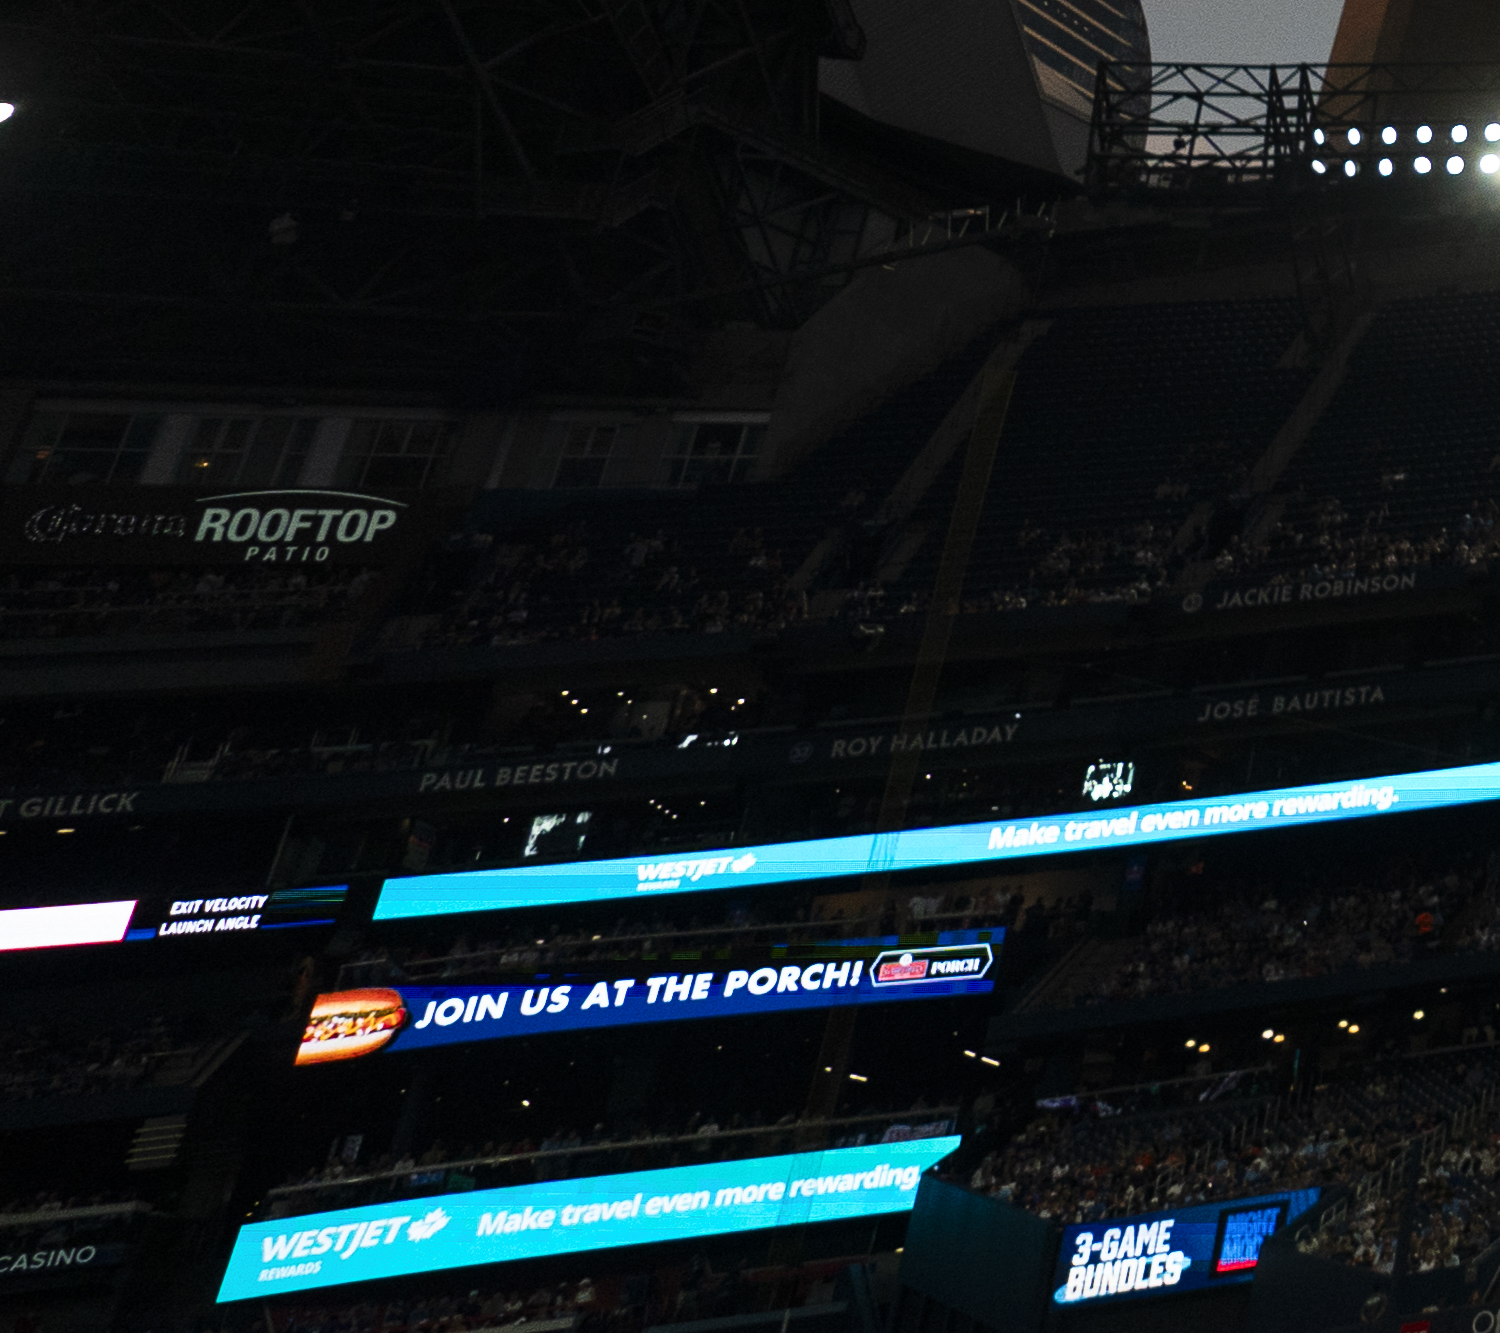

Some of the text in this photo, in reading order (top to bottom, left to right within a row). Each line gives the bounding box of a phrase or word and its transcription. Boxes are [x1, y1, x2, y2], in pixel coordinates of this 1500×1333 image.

[194, 507, 397, 543] ROOFTOP
[244, 546, 330, 563] PATIO
[1215, 584, 1294, 610] JACKIE
[1299, 572, 1416, 601] ROBINSON
[1197, 685, 1386, 723] JOSÉ BAUTISTA
[831, 735, 884, 758] ROY
[889, 723, 1019, 753] HALLADAY
[419, 759, 619, 793] PAUL BEESTON
[19, 791, 141, 819] GILLICK
[988, 784, 1399, 850] Make travel even more rewarding.
[637, 856, 734, 882] WESTJET
[170, 895, 269, 916] EXIT VELOCITY
[159, 914, 262, 936] LAUNCH ANGLE
[931, 958, 980, 975] PORCH
[414, 992, 509, 1030] JOIN
[519, 985, 572, 1016] US
[581, 979, 636, 1011] AT
[646, 972, 713, 1004] THE
[723, 960, 866, 998] PORCH!
[476, 1210, 556, 1237] Make
[560, 1193, 644, 1224] travel
[645, 1190, 710, 1217] even
[714, 1182, 786, 1208] more
[262, 1216, 411, 1263] WESTJET
[1071, 1218, 1176, 1266] 3-GAME
[258, 1261, 322, 1282] REWARDS
[1064, 1250, 1185, 1302] BUNDLES
